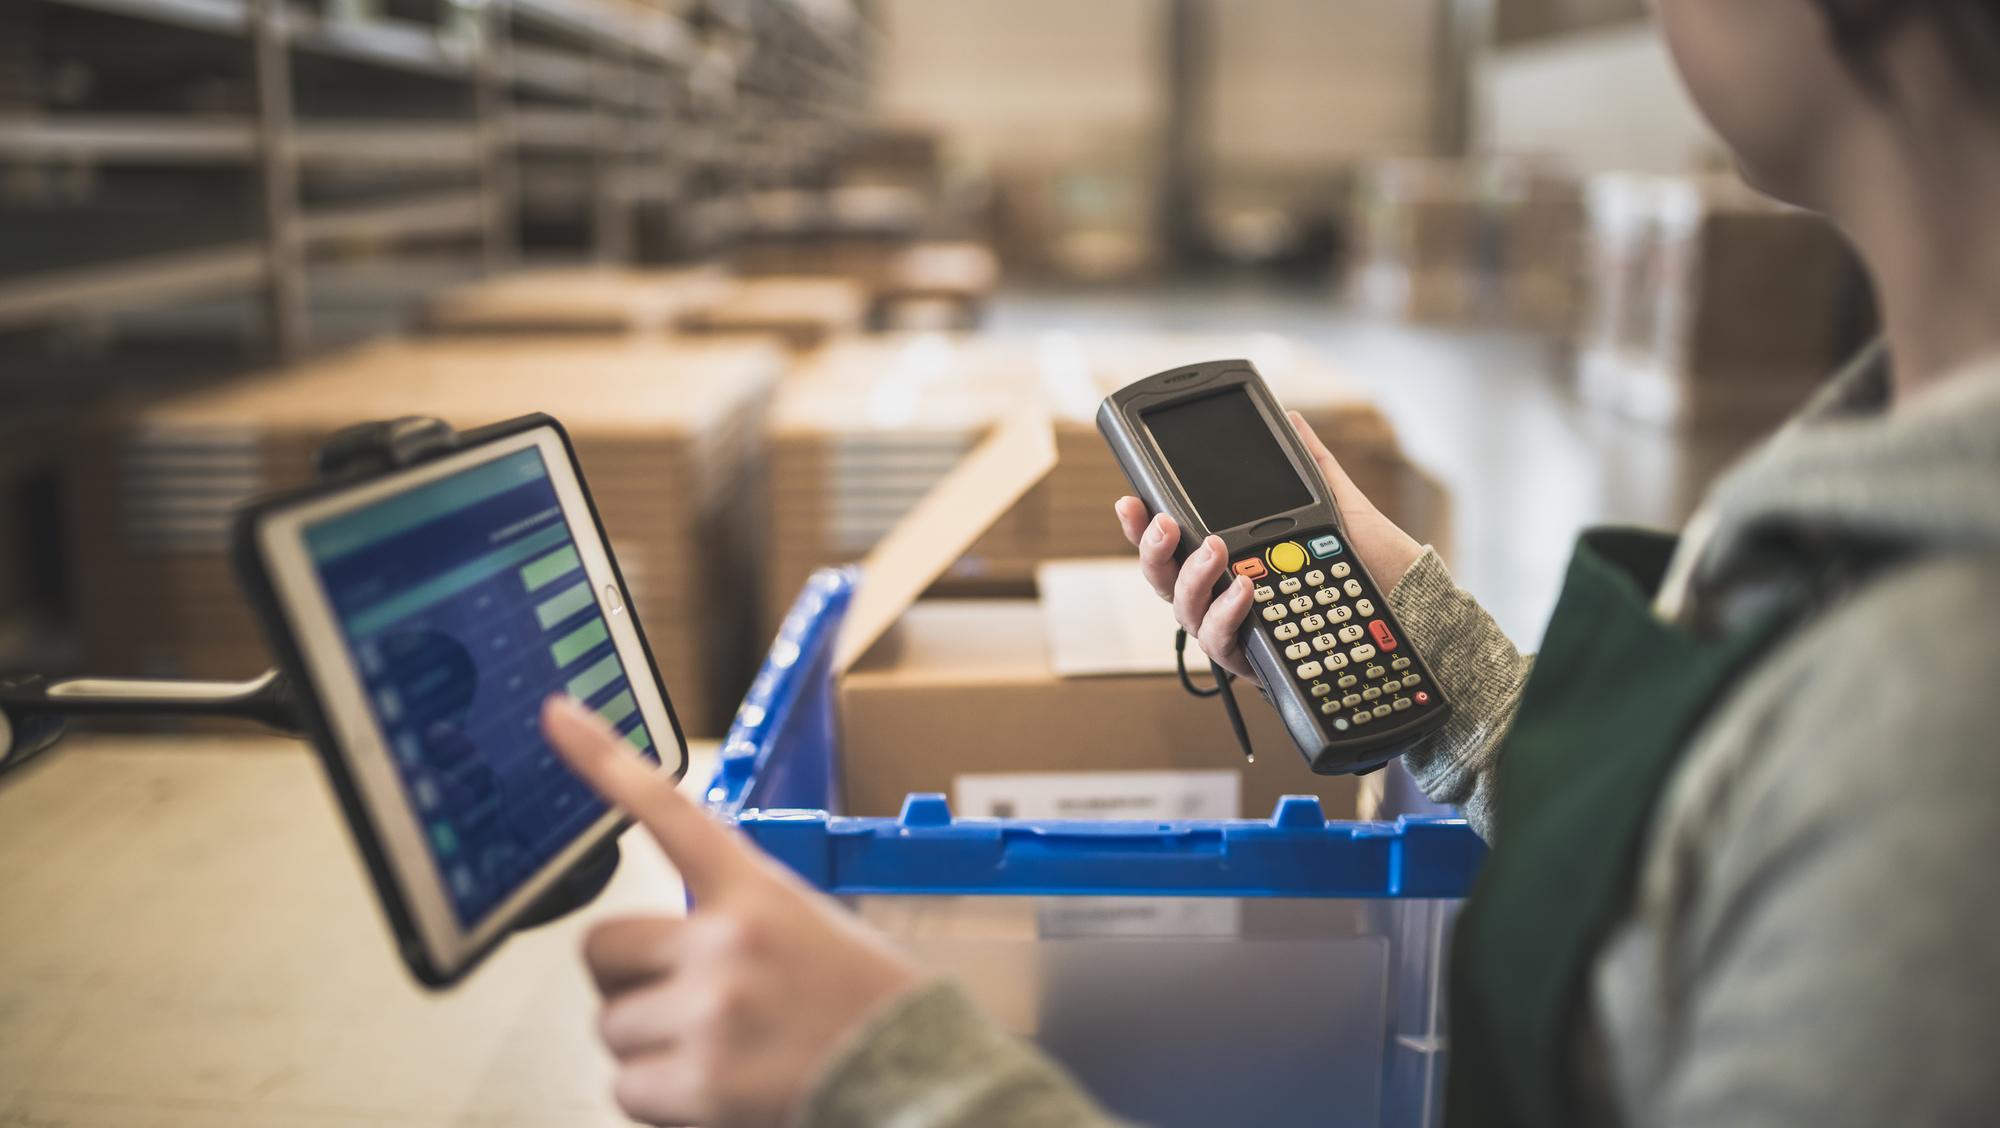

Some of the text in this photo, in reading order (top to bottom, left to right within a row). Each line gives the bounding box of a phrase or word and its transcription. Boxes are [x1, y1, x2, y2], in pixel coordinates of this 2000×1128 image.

[1325, 590, 1333, 598] 3
[1298, 598, 1307, 607] 2
[1272, 606, 1279, 615] 1
[1336, 608, 1345, 617] 6
[1310, 617, 1318, 625] 5
[1284, 625, 1292, 634] 4
[1348, 627, 1357, 636] 9
[1321, 636, 1330, 645] 8
[1294, 644, 1301, 654] 7
[1333, 655, 1342, 664] 0
